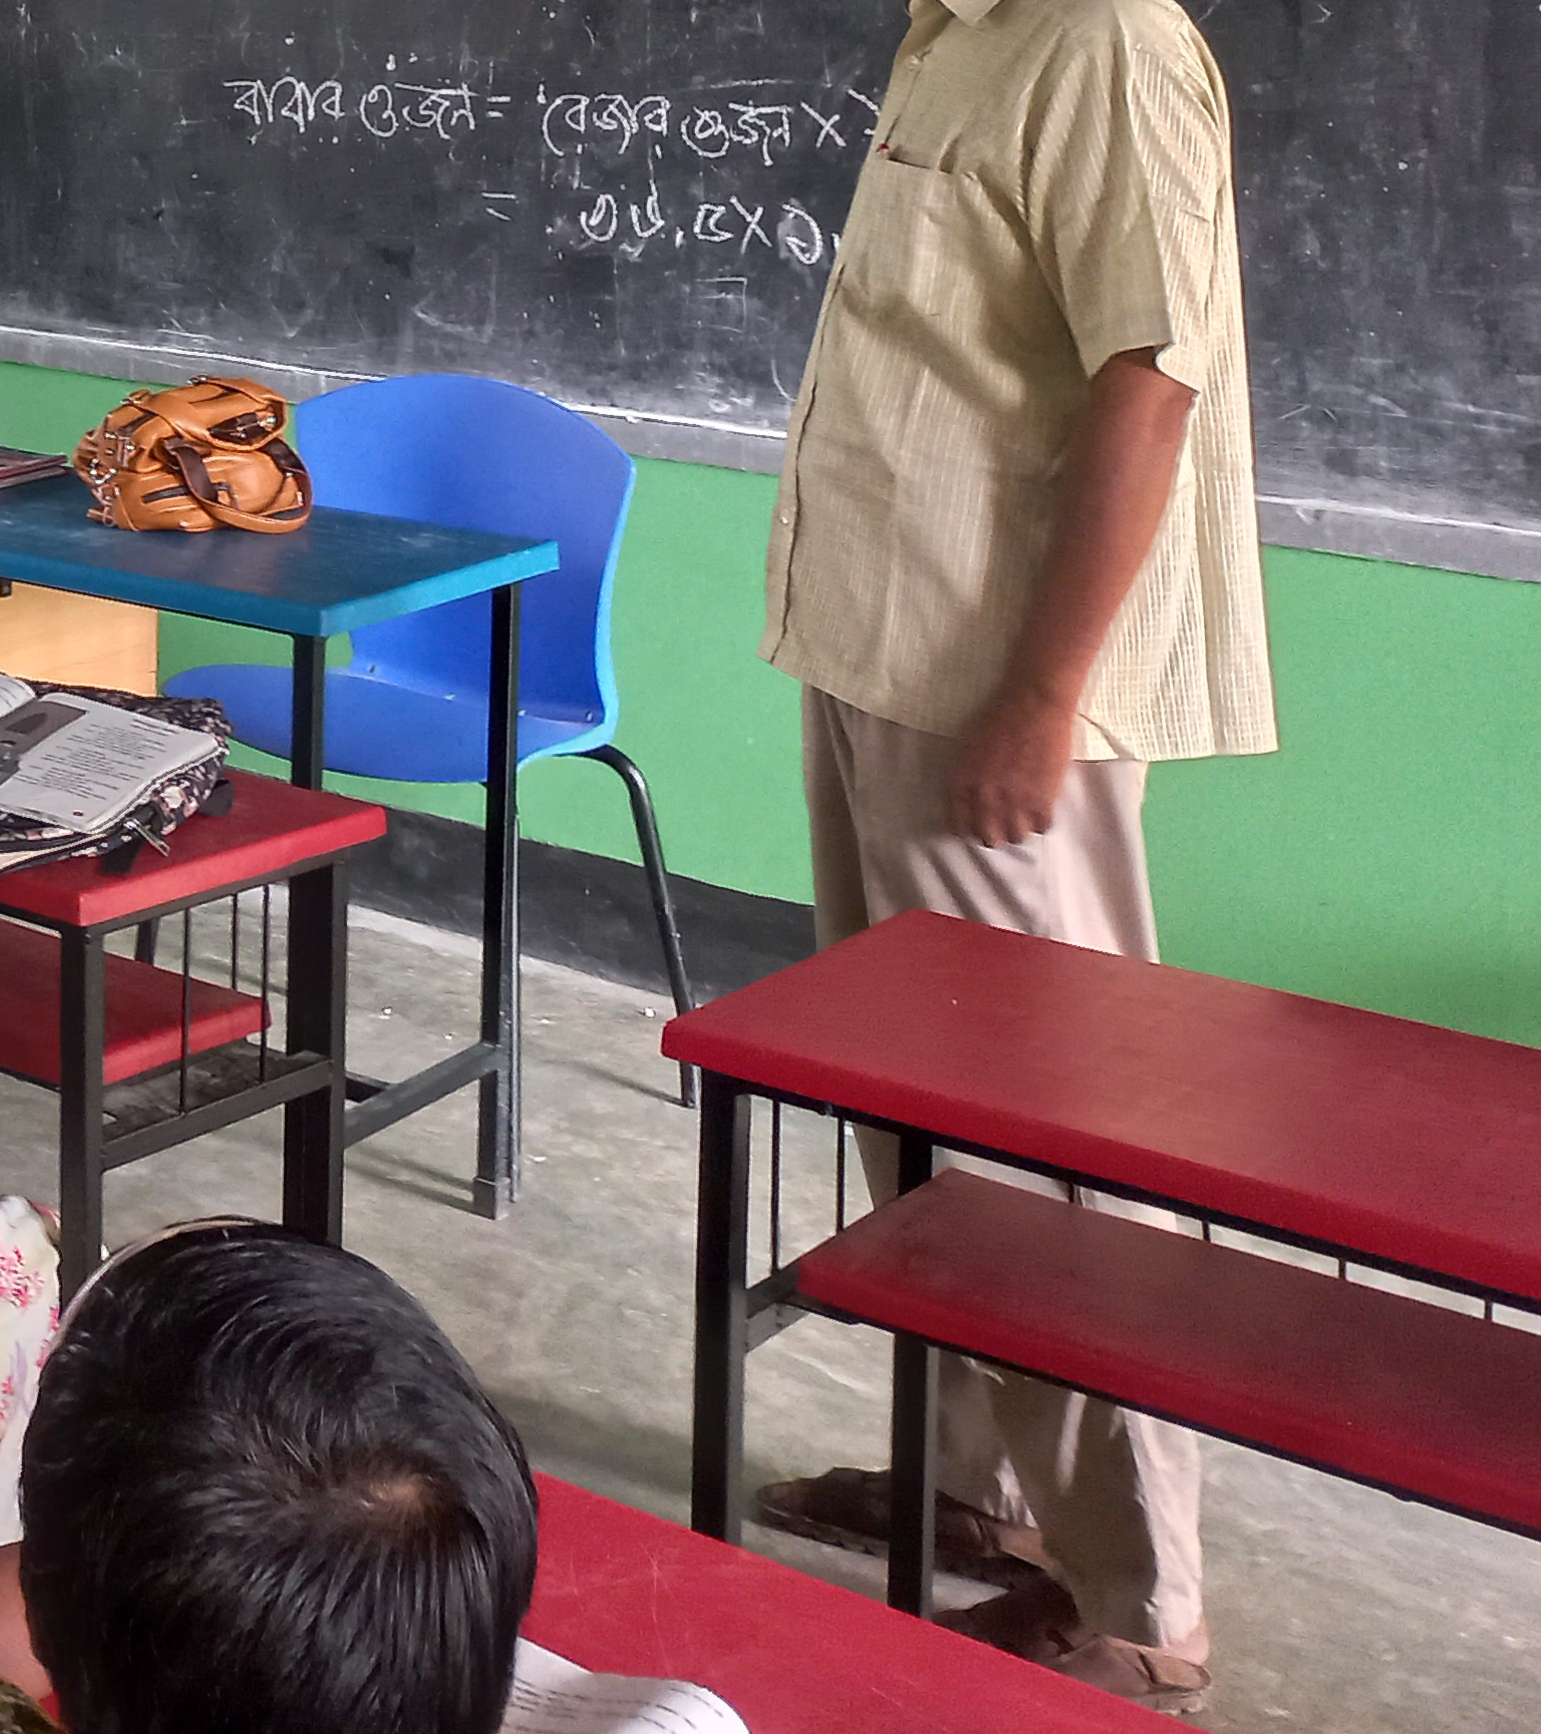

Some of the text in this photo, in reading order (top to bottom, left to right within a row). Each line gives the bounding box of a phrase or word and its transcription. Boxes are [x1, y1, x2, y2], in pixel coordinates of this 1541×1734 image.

[222, 76, 345, 144] বাবার
[360, 83, 480, 140] ওজন
[542, 93, 669, 159] রেজার
